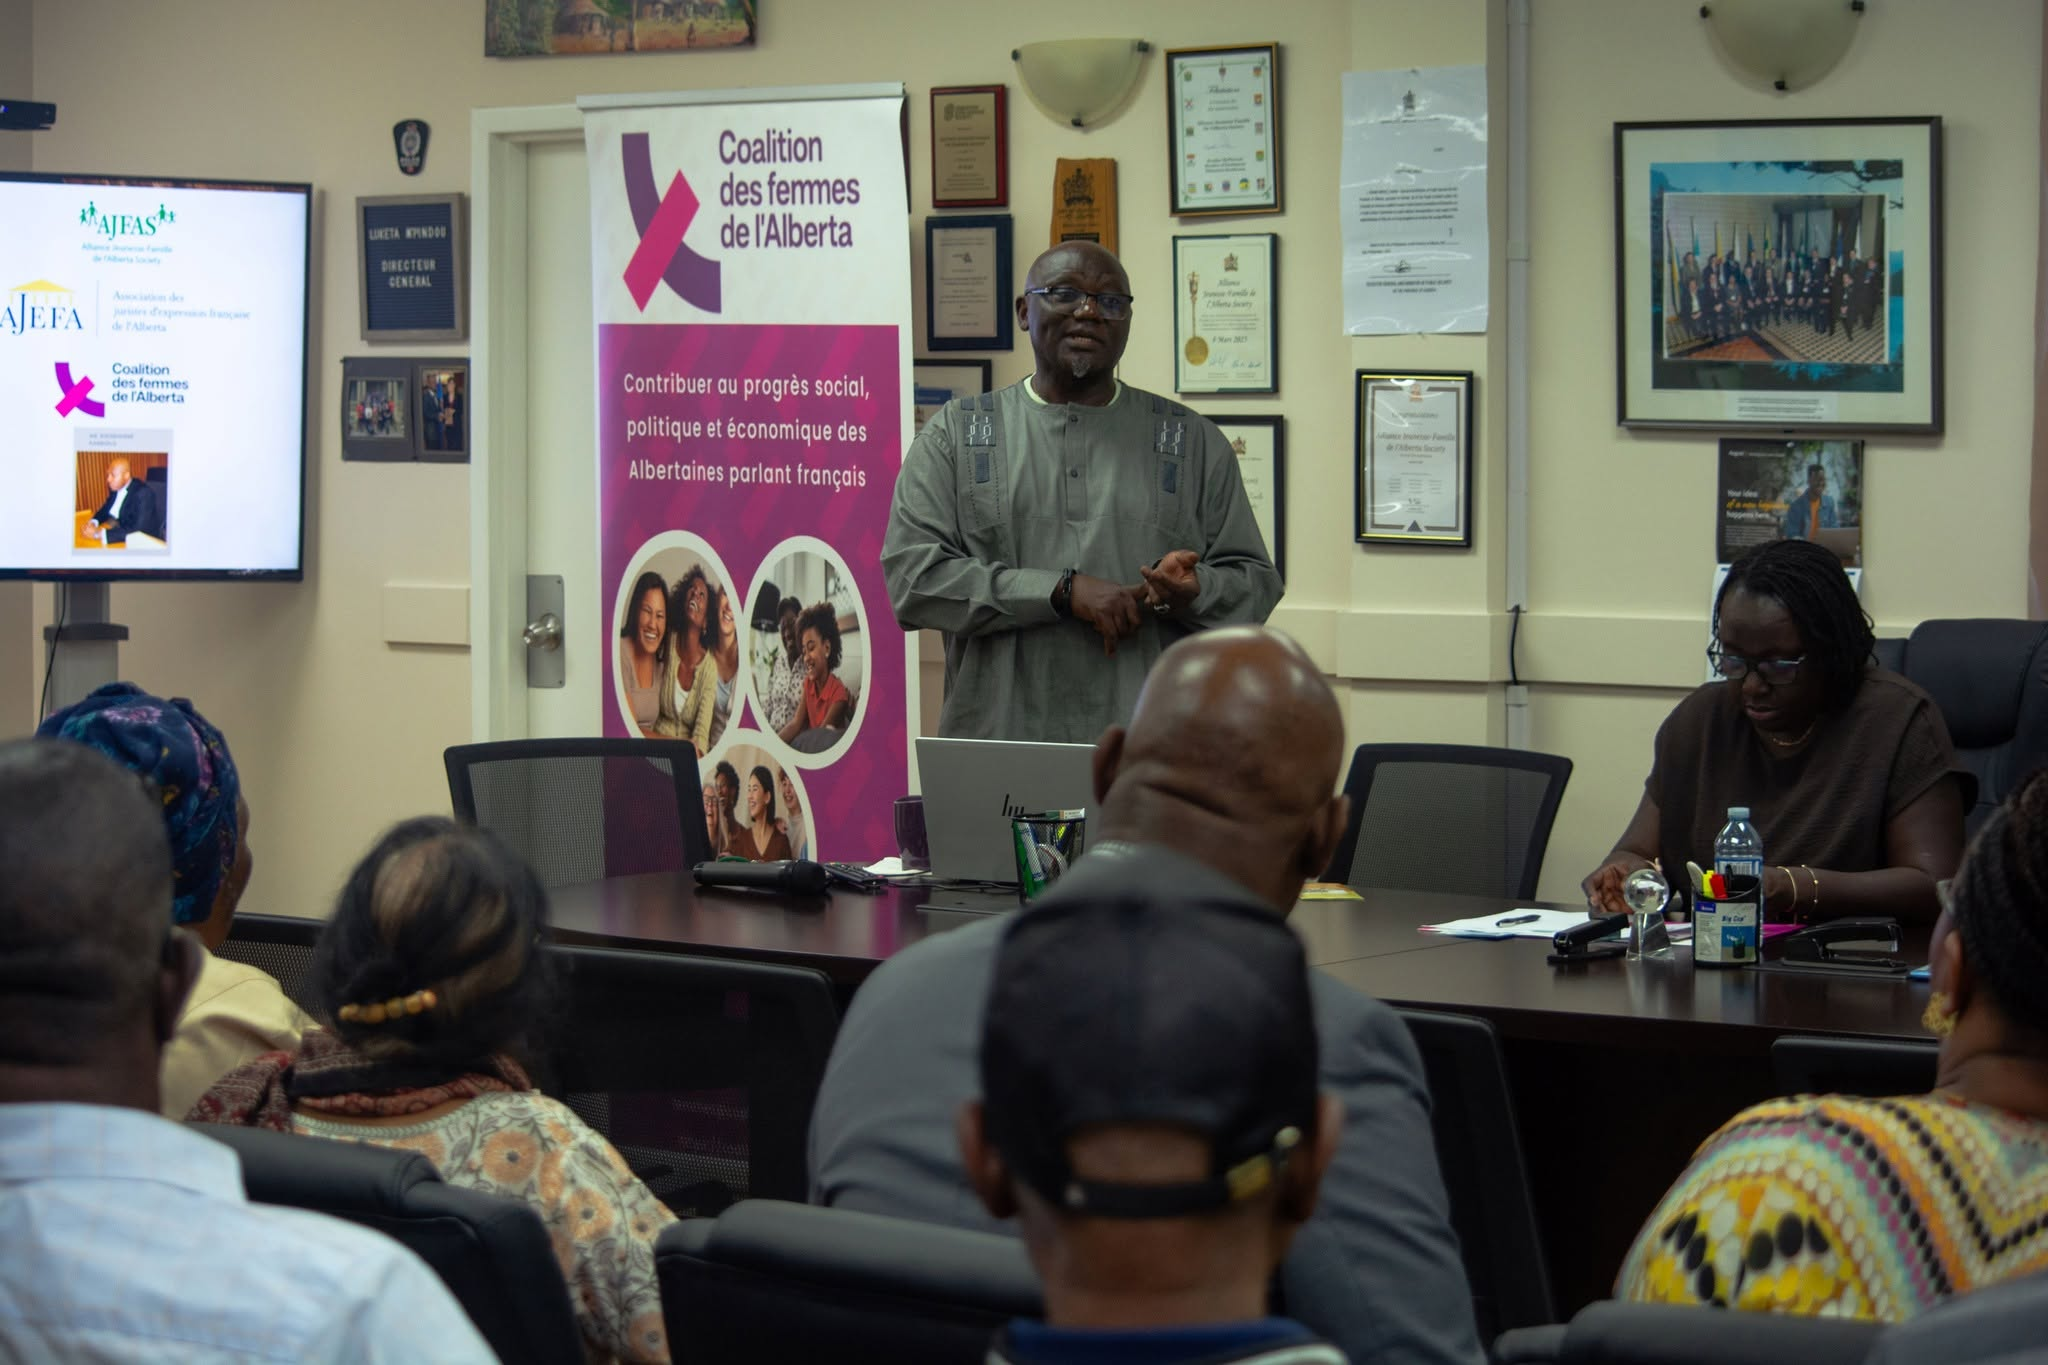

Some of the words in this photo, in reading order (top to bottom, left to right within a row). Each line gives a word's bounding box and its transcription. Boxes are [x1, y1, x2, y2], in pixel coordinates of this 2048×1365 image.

[719, 130, 823, 164] Coalition
[720, 172, 763, 206] des
[768, 172, 860, 205] femmes
[98, 214, 156, 240] AJFAS
[369, 227, 400, 241] LUKETA
[721, 214, 750, 248] de
[755, 213, 853, 248] l'Alberta
[93, 254, 102, 262] de
[381, 259, 436, 272] DIRECTEUR
[389, 275, 432, 288] GENERAL
[113, 291, 166, 302] Association
[169, 291, 184, 302] des
[0, 294, 84, 335] AJEFA
[113, 308, 147, 319] juristes
[112, 320, 122, 331] de
[126, 320, 167, 332] l'Alberta
[112, 362, 170, 376] Coalition
[112, 377, 136, 389] des
[139, 378, 189, 390] femmes
[624, 373, 713, 395] Contribuer
[718, 380, 738, 395] au
[744, 375, 809, 401] progrès
[815, 376, 870, 401] social,
[112, 391, 128, 403] de
[131, 391, 185, 404] l'Alberta
[627, 416, 702, 443] politique
[707, 419, 723, 438] et
[727, 417, 832, 446] économique
[838, 421, 867, 442] des
[629, 460, 724, 482] Albertaines
[730, 463, 791, 489] parlant
[797, 463, 867, 492] français
